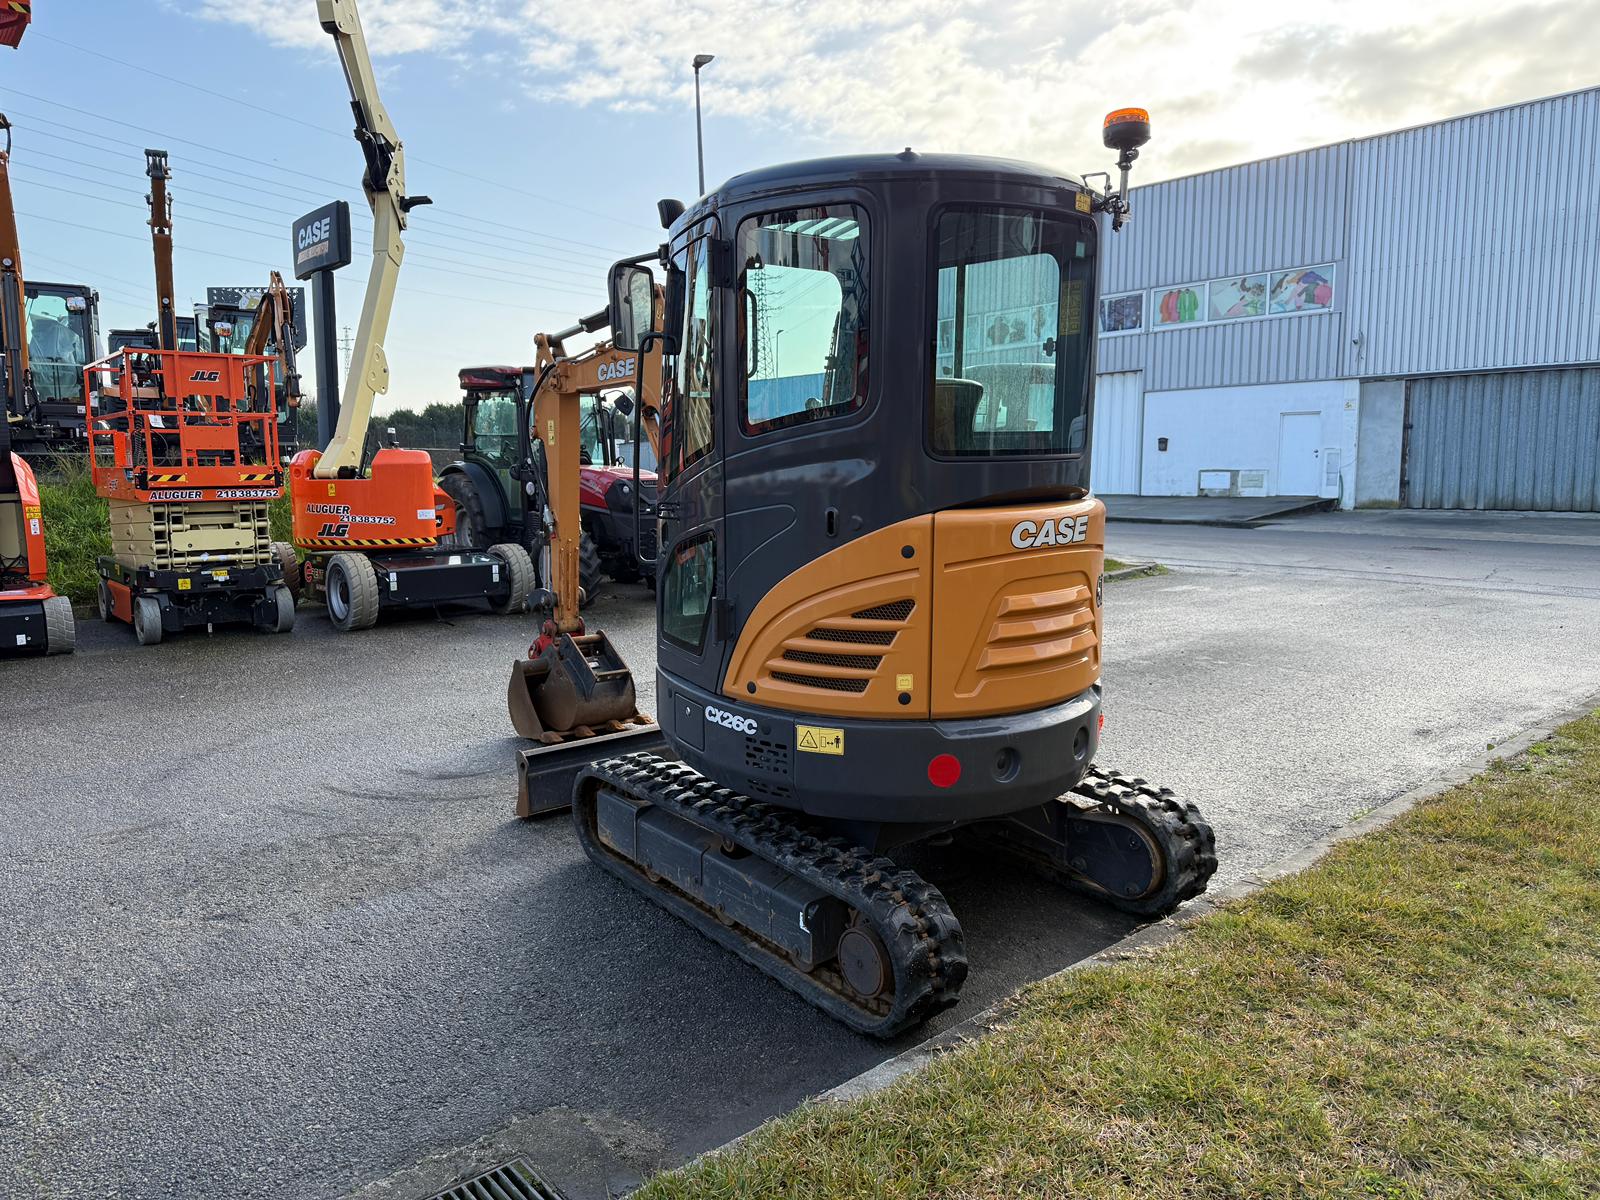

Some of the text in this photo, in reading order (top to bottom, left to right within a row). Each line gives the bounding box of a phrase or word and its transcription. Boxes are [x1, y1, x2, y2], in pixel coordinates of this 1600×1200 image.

[299, 218, 330, 249] CASE
[190, 371, 218, 381] JLG
[598, 359, 634, 380] CASE
[150, 489, 279, 500] ALUGUER 218383752
[306, 503, 350, 514] ALUGUER
[340, 515, 395, 524] 218383752
[318, 524, 349, 537] JLG
[1011, 515, 1088, 548] CASE
[705, 706, 758, 735] CX26C
